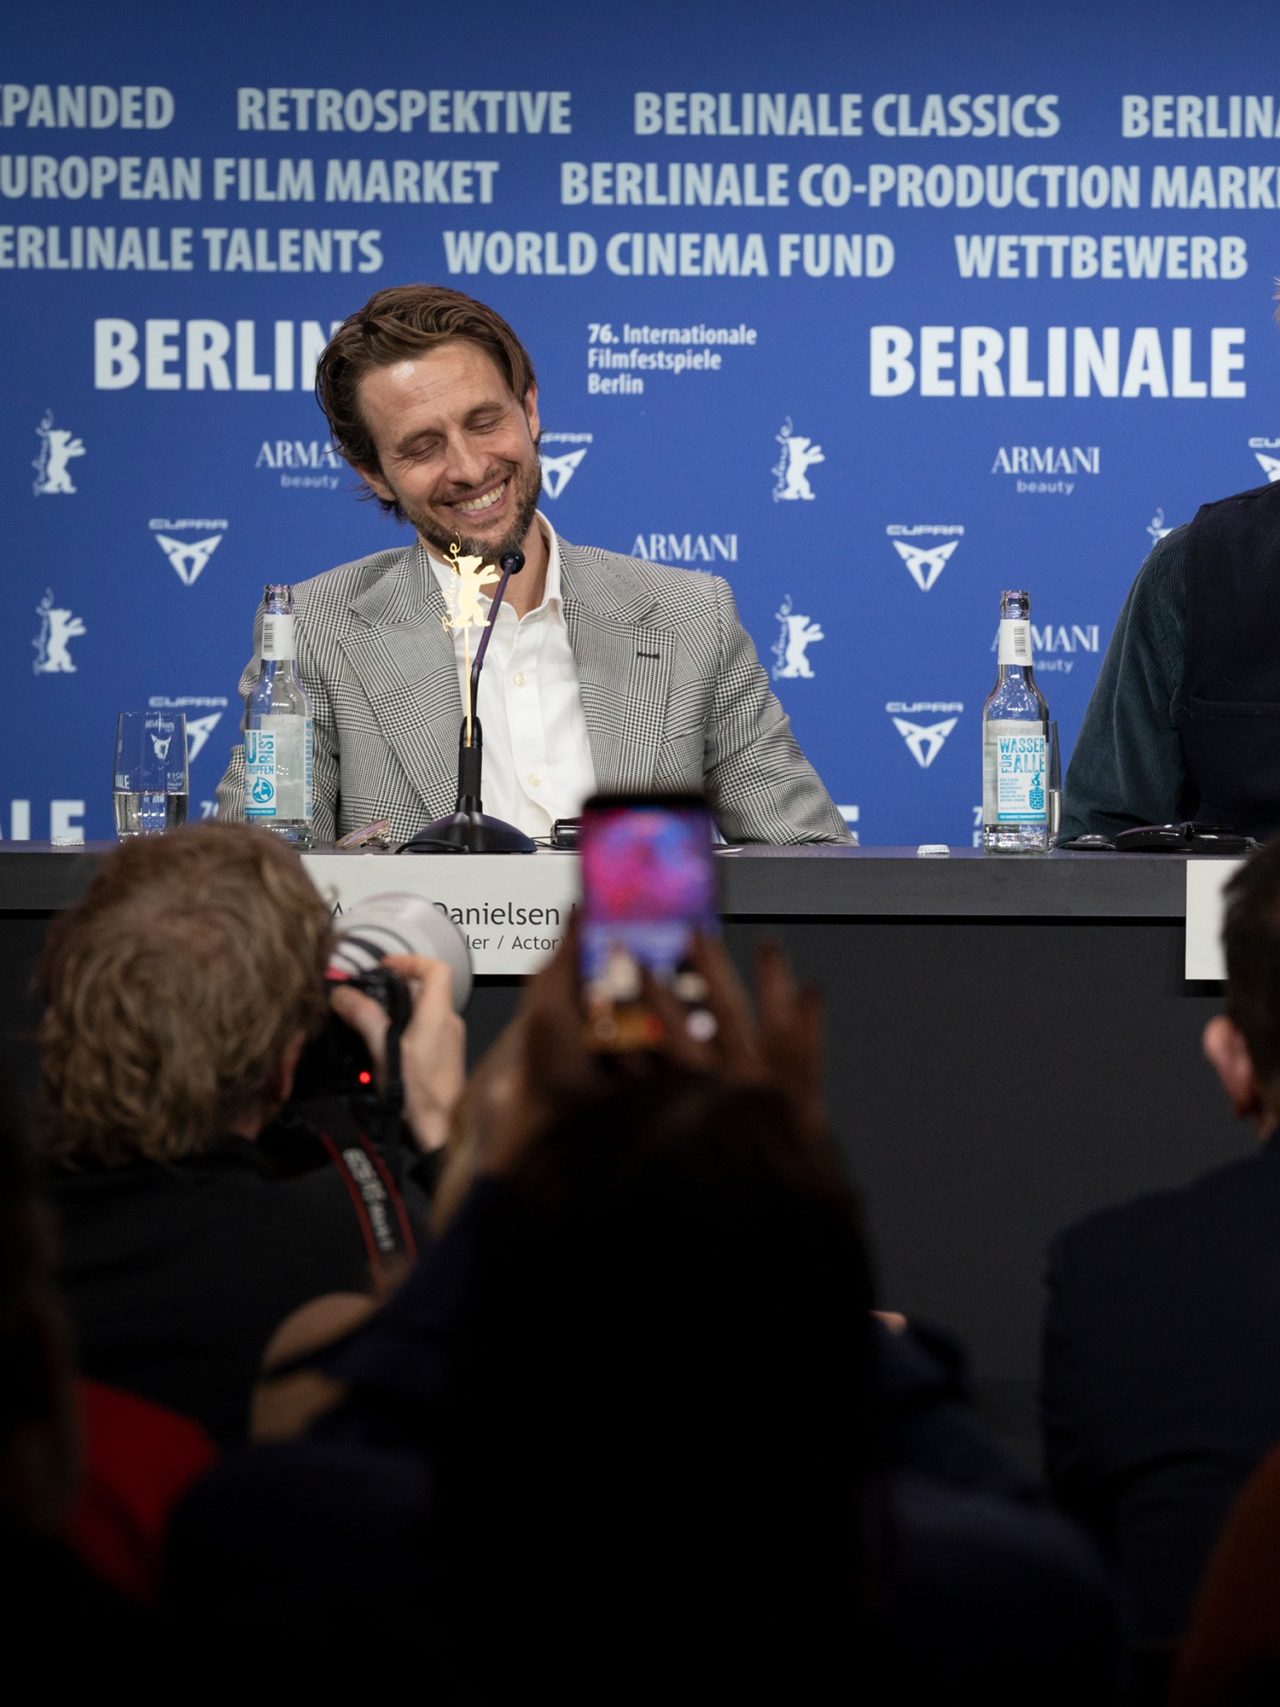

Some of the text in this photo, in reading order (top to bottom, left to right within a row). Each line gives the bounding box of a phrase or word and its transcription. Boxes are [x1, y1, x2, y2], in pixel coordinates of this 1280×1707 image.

[0, 84, 175, 130] PANDED
[237, 88, 572, 134] RETROSPEKTIVE
[634, 92, 1061, 138] BERLINALE CLASSICS
[213, 158, 315, 201] FILM
[325, 160, 500, 204] MARKET
[560, 162, 790, 206] BERLINALE
[798, 164, 1141, 208] CO-PRODUCTION
[202, 229, 384, 273] TALENTS
[442, 231, 895, 277] WORLD CINEMA FUND
[954, 235, 1249, 280] WETTBEWERB
[587, 323, 758, 346] 76. Internationale
[587, 348, 722, 374] Filmfestspiele
[869, 325, 1247, 398] BERLINALE
[587, 373, 644, 394] Berlin
[255, 440, 342, 469] ARMA
[992, 446, 1100, 475] ARMANI
[280, 473, 339, 490] beauty
[1016, 478, 1075, 495] beauty
[631, 533, 738, 562] ARMANI
[1000, 737, 1045, 753] WASSER
[1013, 753, 1045, 773] ALLE
